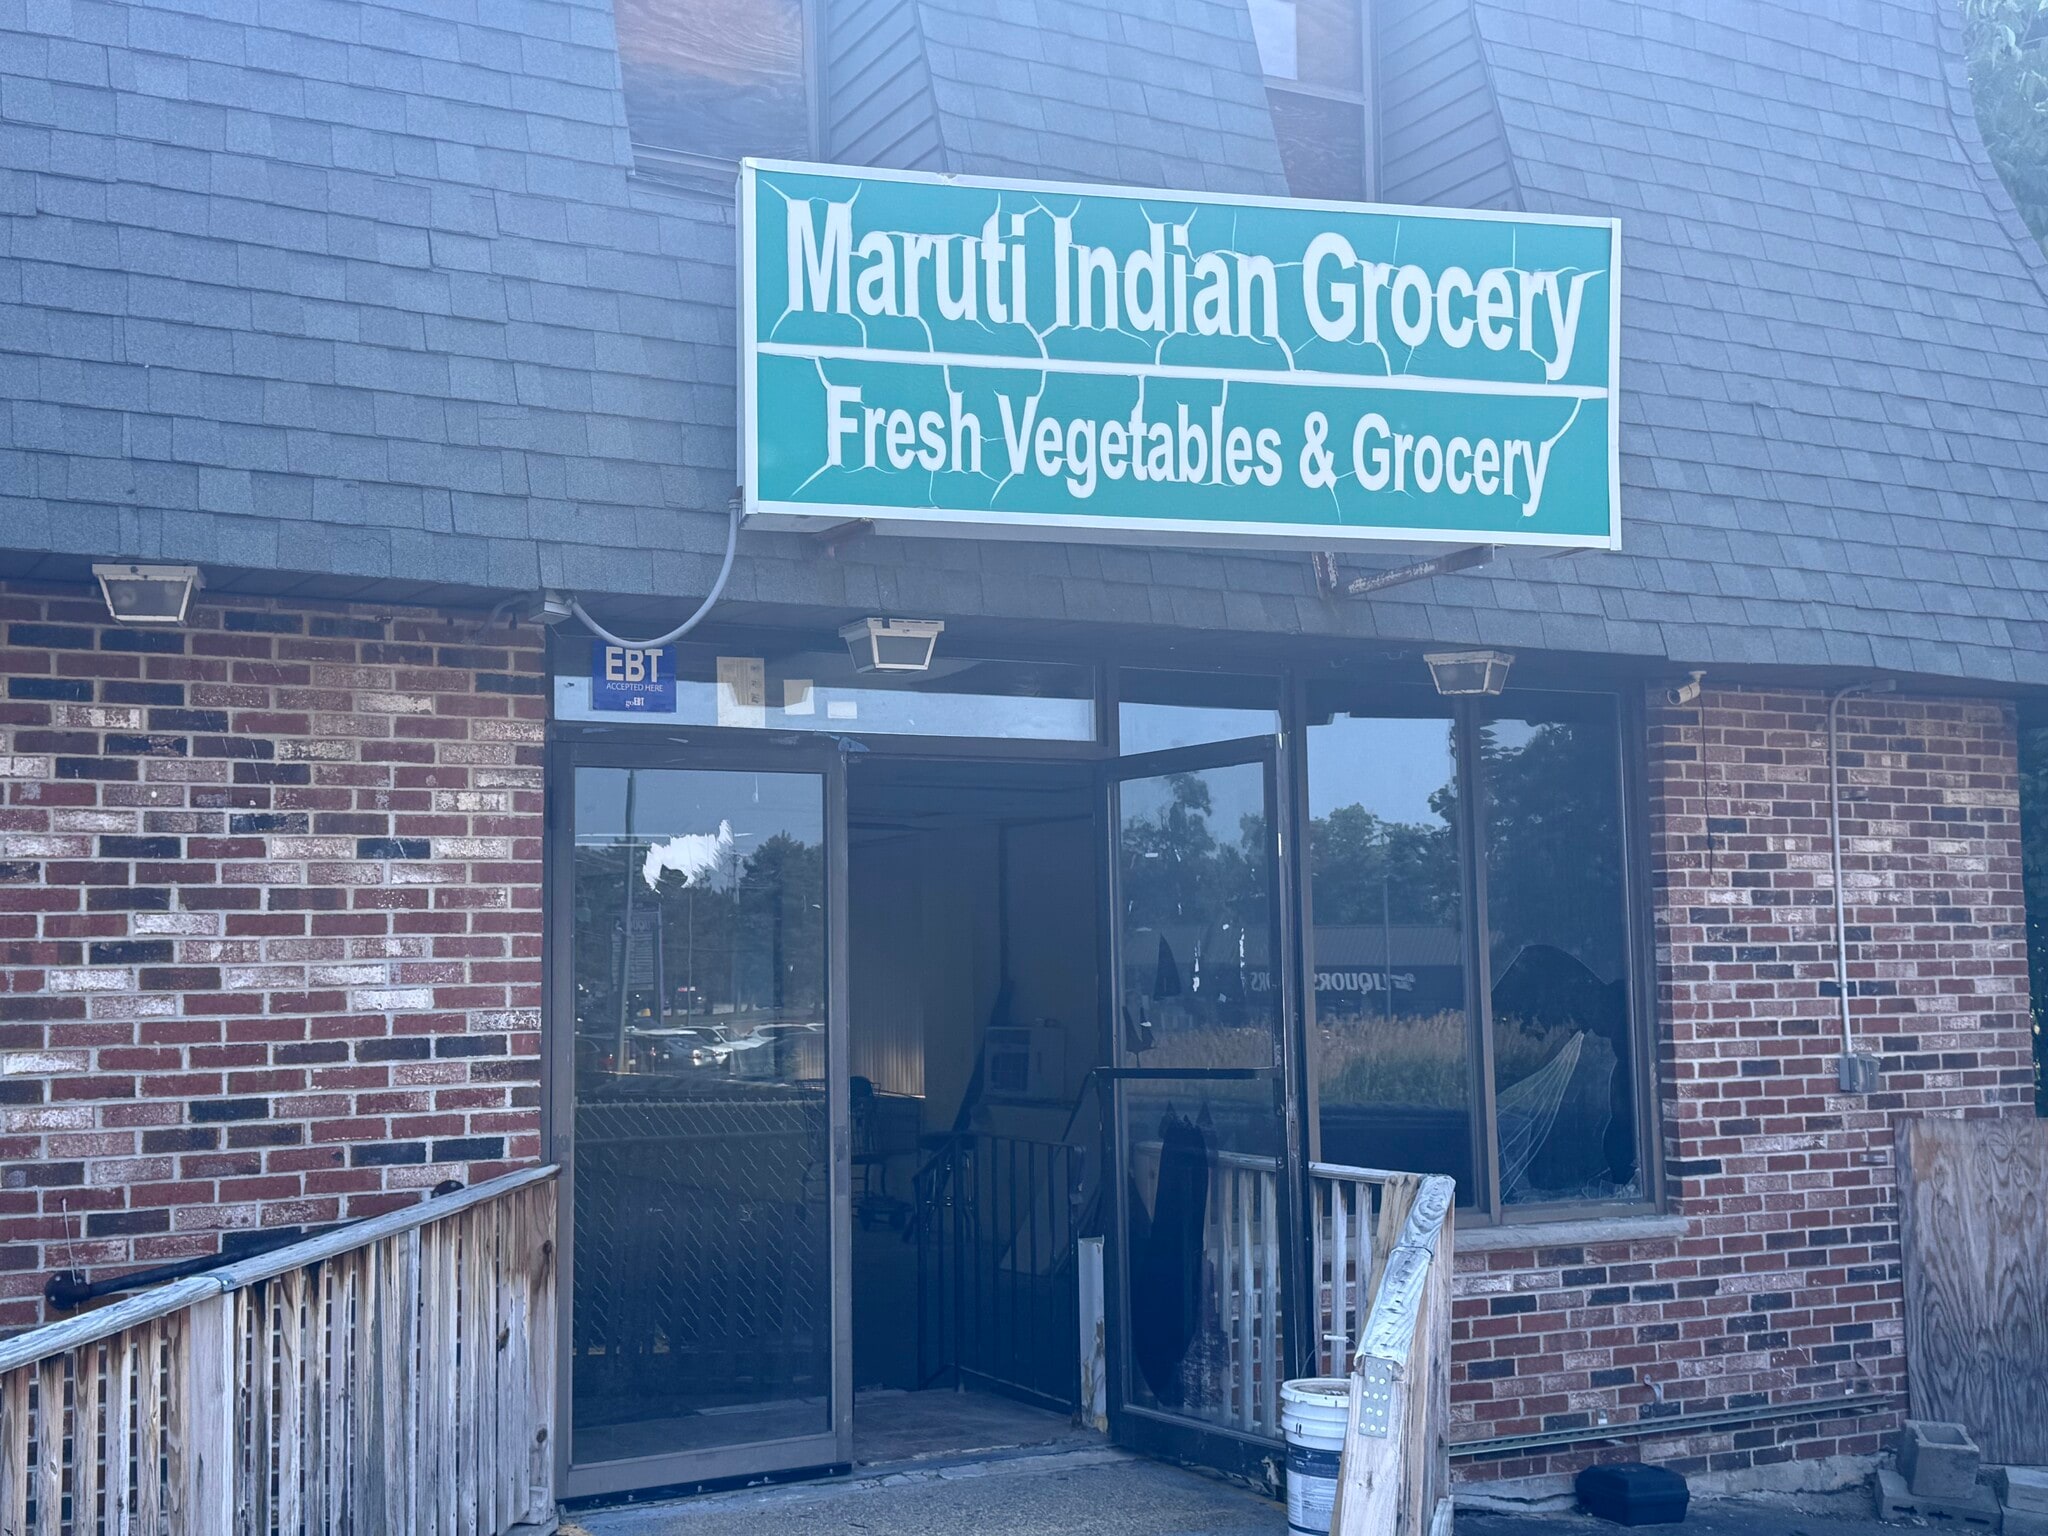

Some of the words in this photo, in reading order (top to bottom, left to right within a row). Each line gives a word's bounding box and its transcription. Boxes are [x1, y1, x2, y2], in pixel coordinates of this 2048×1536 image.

[786, 199, 1026, 325] Maruti
[1056, 216, 1278, 337] Indian
[1303, 232, 1586, 380] Grocery
[827, 386, 982, 472] Fresh
[1000, 393, 1282, 498] Vegetables
[1300, 410, 1336, 488] &
[1354, 413, 1550, 516] Grocery
[606, 646, 663, 683] EBT
[606, 682, 644, 691] ACCEPTED
[645, 684, 663, 692] HERE
